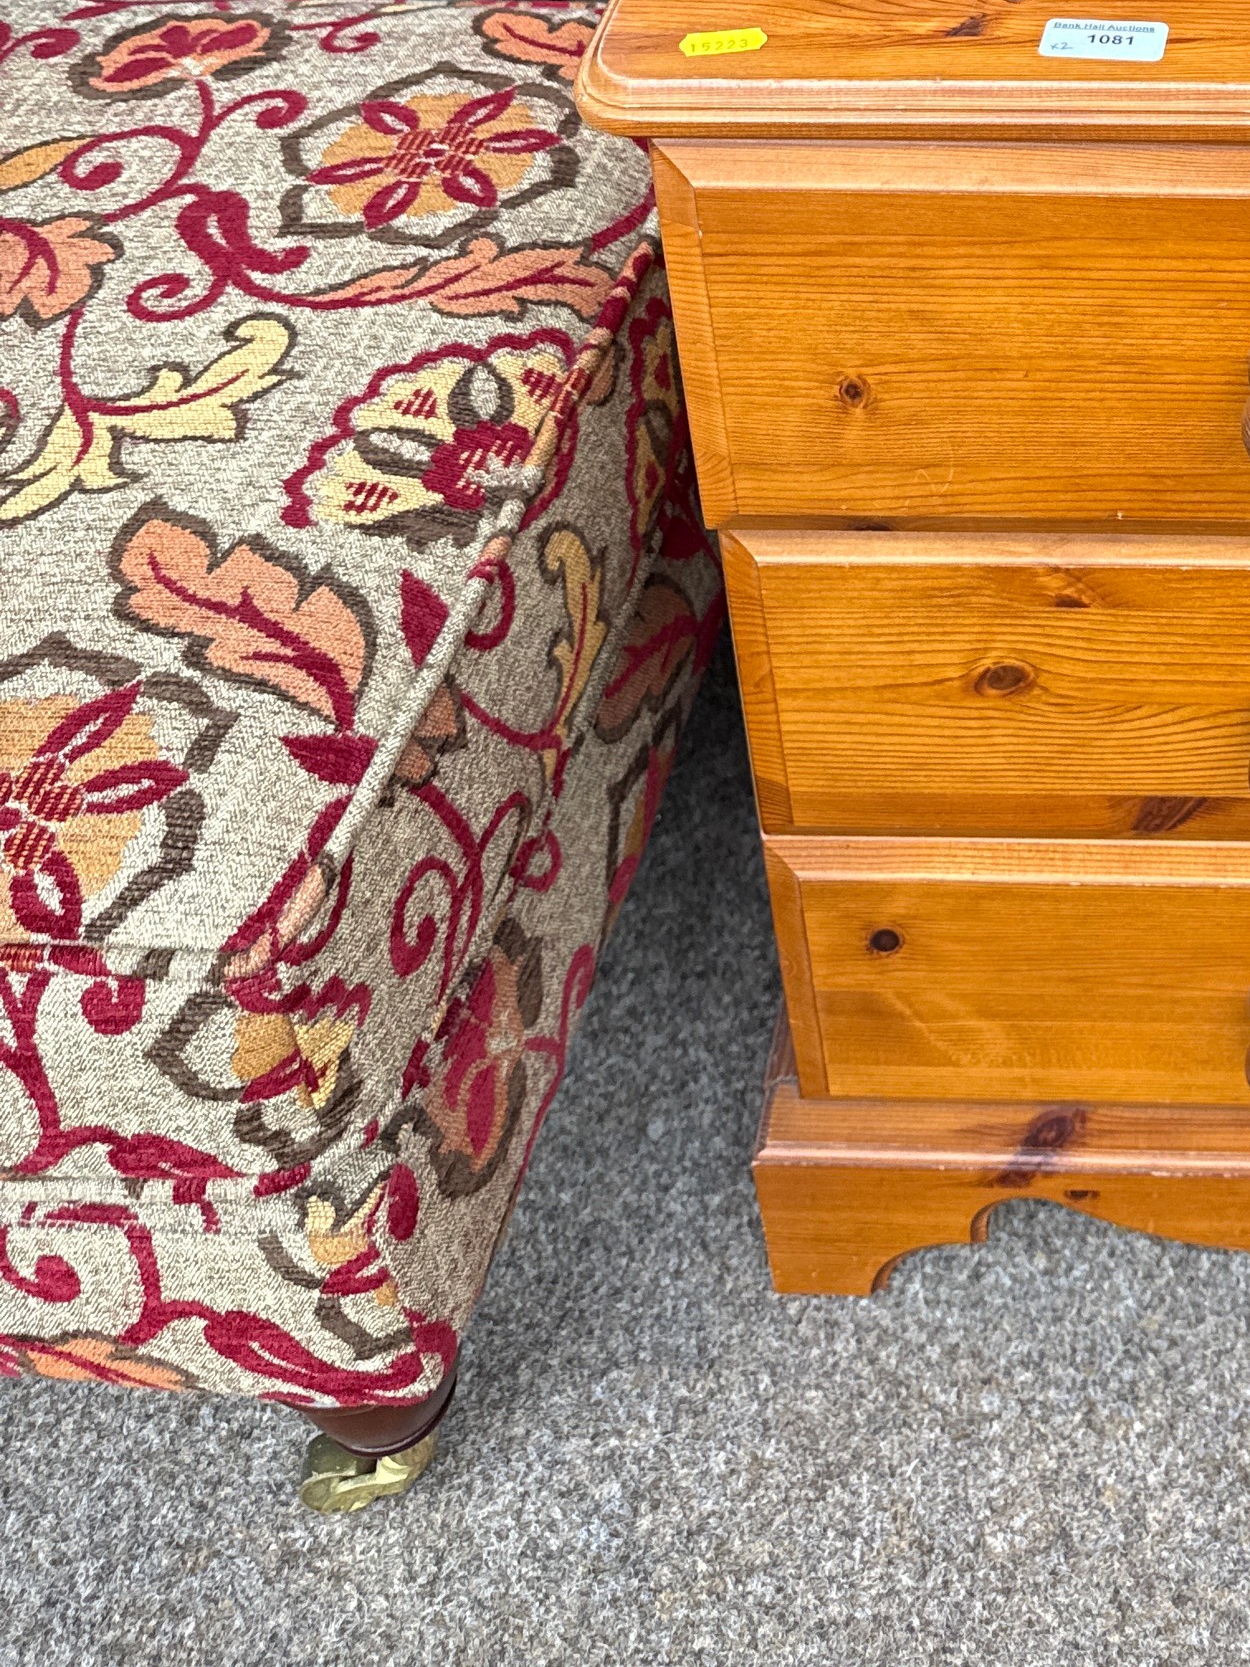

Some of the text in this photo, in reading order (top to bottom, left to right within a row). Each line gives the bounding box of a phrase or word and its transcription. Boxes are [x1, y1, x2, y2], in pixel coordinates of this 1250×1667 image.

[1053, 21, 1155, 33] Bank Hall Auctions
[690, 39, 748, 53] 15223
[1087, 34, 1135, 46] 1081
